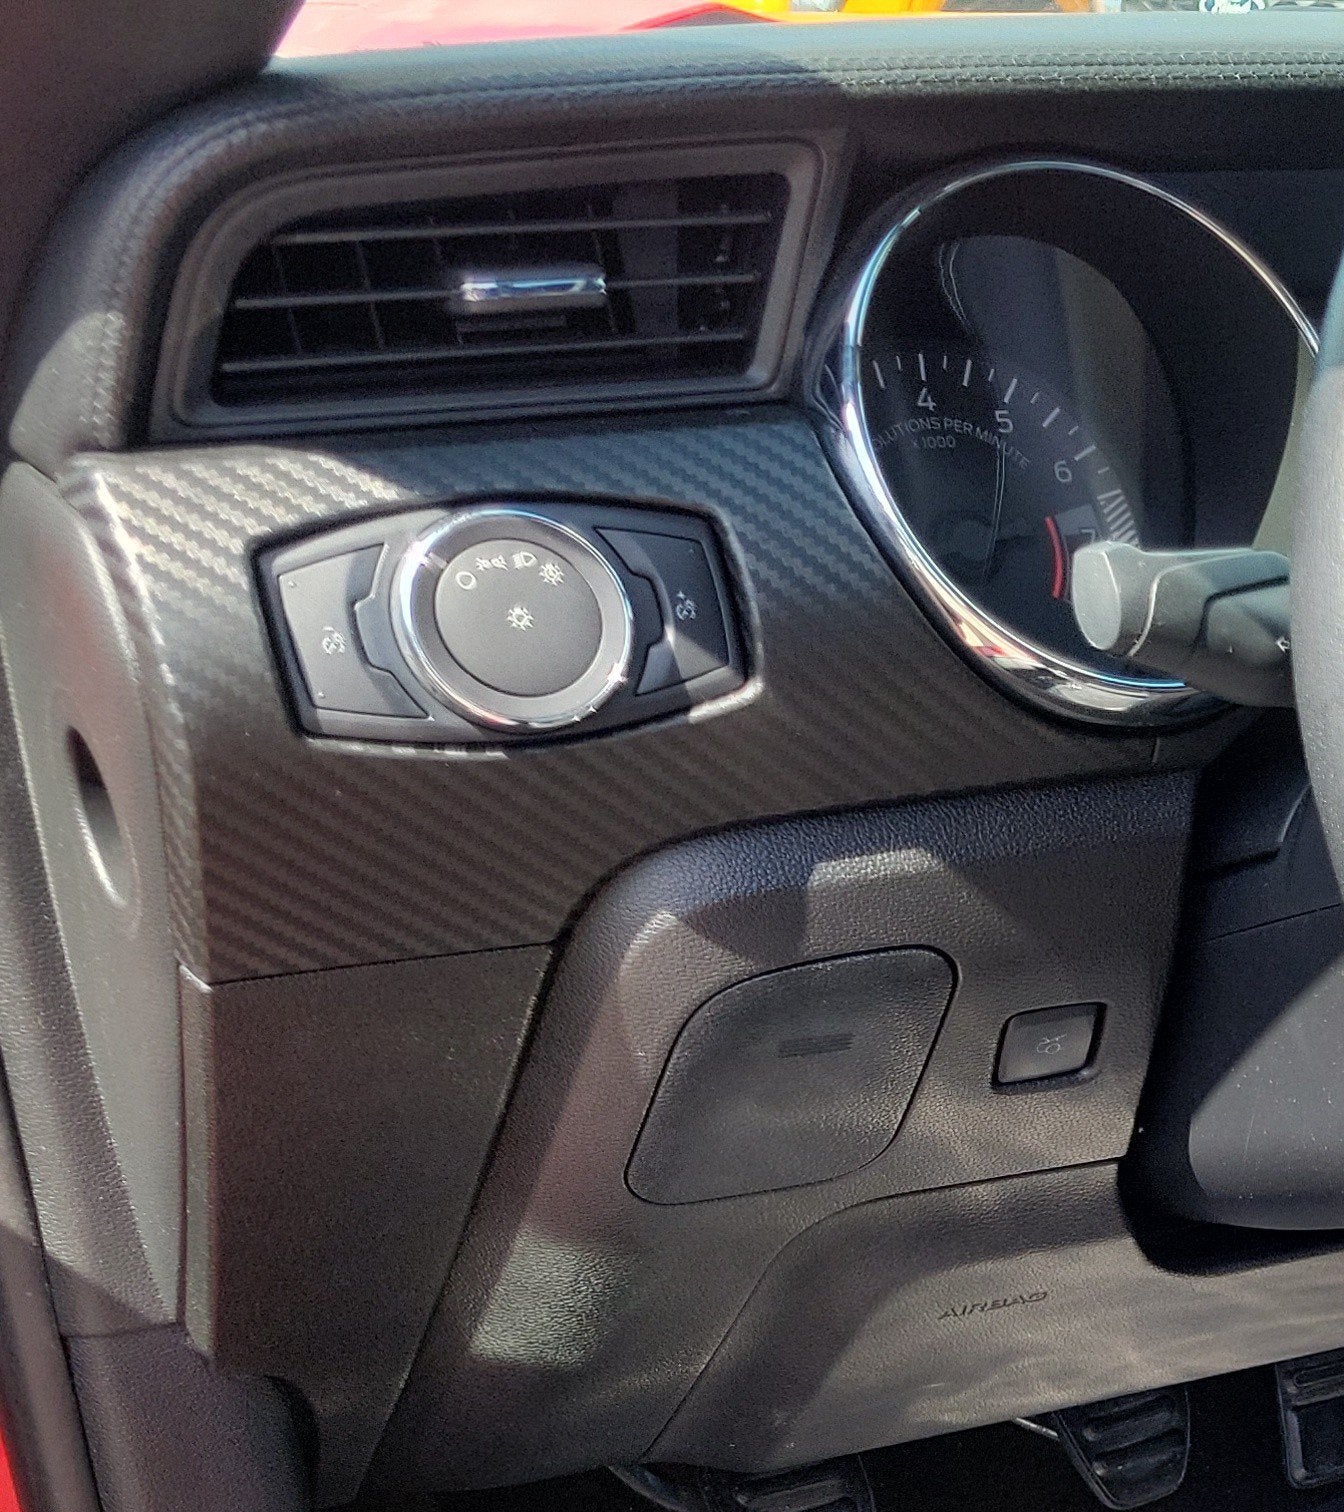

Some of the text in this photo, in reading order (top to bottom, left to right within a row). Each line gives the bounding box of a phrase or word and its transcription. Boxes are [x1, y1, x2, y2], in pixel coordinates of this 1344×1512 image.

[917, 387, 936, 411] 4
[944, 418, 974, 435] PER
[995, 409, 1014, 433] 5
[1053, 460, 1073, 483] 6
[937, 1291, 1050, 1321] AIRBAG
